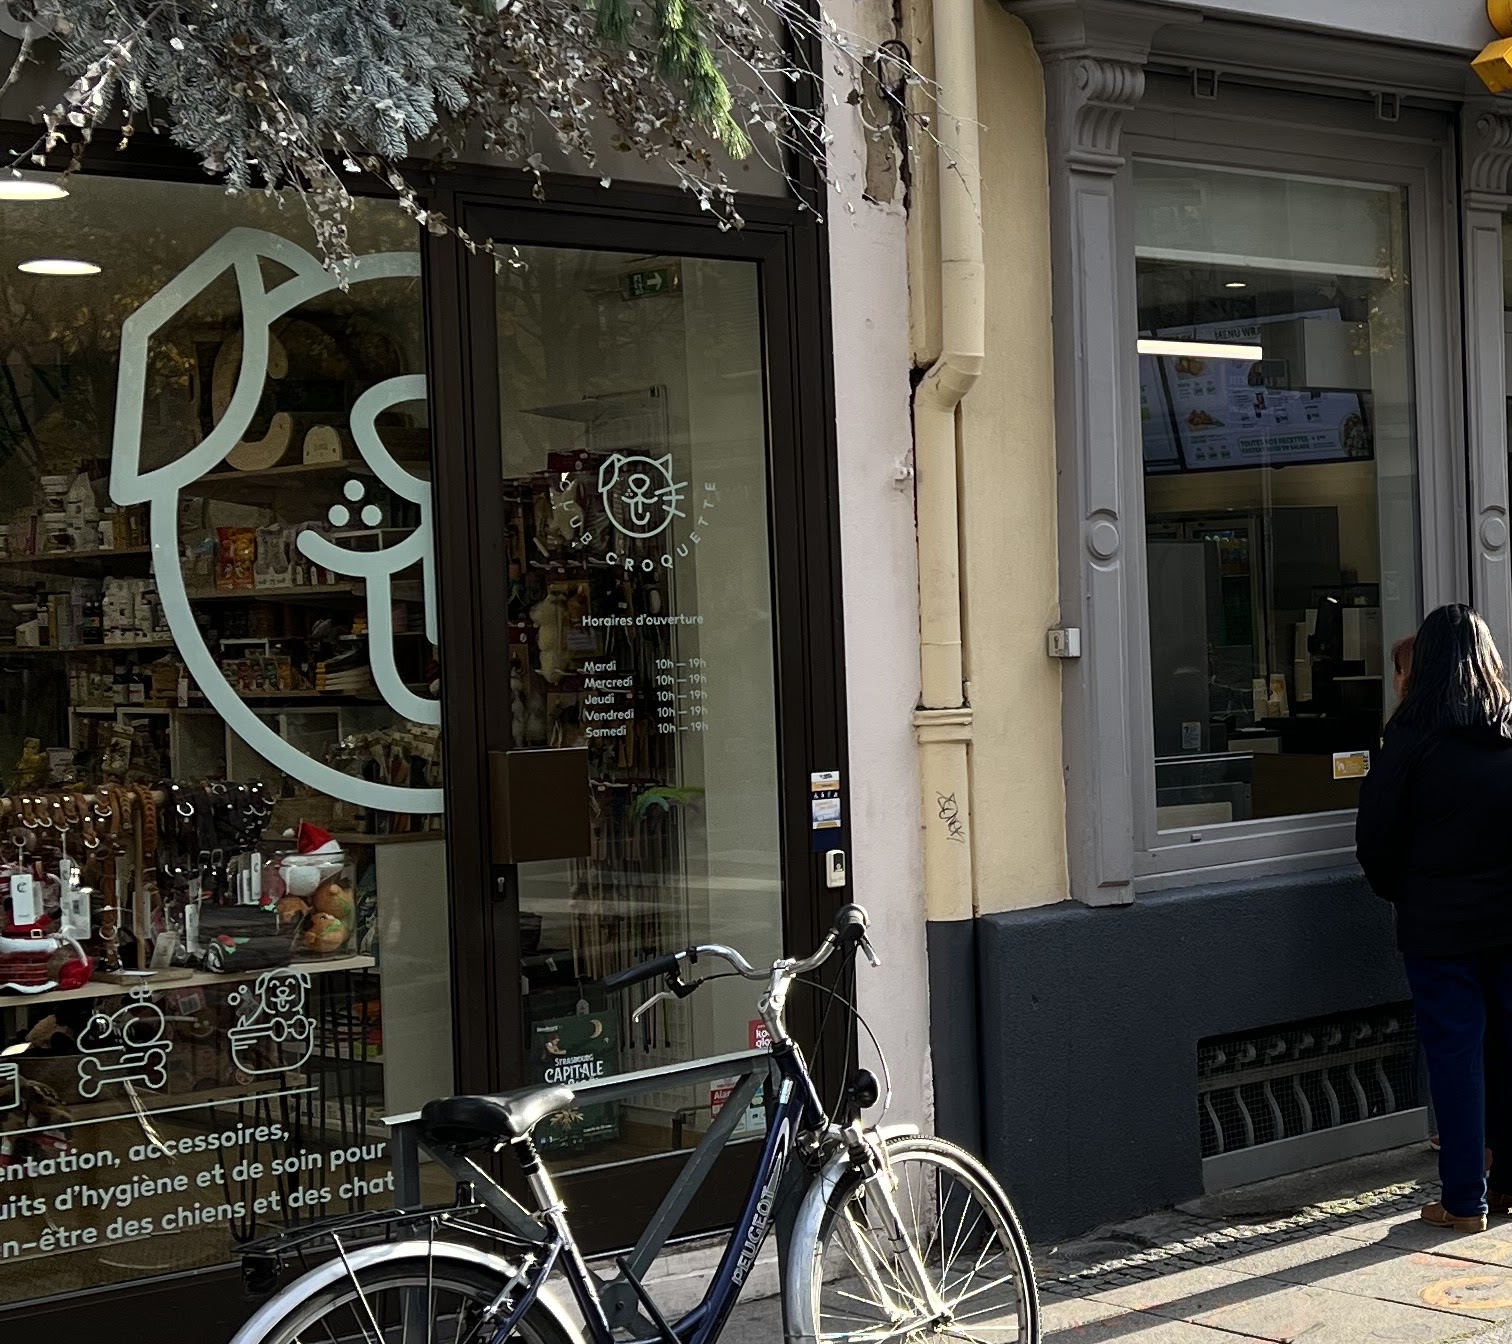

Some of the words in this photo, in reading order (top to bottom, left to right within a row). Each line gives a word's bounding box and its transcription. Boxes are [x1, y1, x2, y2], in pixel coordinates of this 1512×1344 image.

[606, 483, 716, 571] CROQUETTE
[582, 614, 633, 627] Horaires
[636, 614, 704, 626] d'ouverture
[584, 660, 616, 672] Mardi
[656, 659, 674, 669] 10h
[689, 658, 706, 668] 19h
[584, 676, 633, 688] Mercredi
[656, 675, 675, 685] 10h
[689, 674, 707, 684] 19h
[585, 693, 615, 705] Jeudi
[657, 691, 675, 702] 10h
[690, 690, 708, 700] 19h
[585, 709, 634, 721] Vendredi
[657, 707, 676, 718] 10h
[690, 706, 708, 716] 19h
[586, 725, 626, 737] Samedi
[658, 723, 676, 734] 10h
[691, 722, 709, 732] 19h
[544, 1061, 604, 1084] CAPITALE
[128, 1122, 290, 1163] accessoires,
[54, 1174, 189, 1211] d'hygiène
[196, 1163, 225, 1190] et
[232, 1154, 265, 1182] de
[271, 1147, 322, 1175] soin
[329, 1139, 388, 1171] pour
[106, 1216, 154, 1240] des
[160, 1200, 246, 1230] chiens
[253, 1190, 282, 1213] et
[287, 1182, 332, 1208] des
[731, 1185, 775, 1286] PEUGEOT
